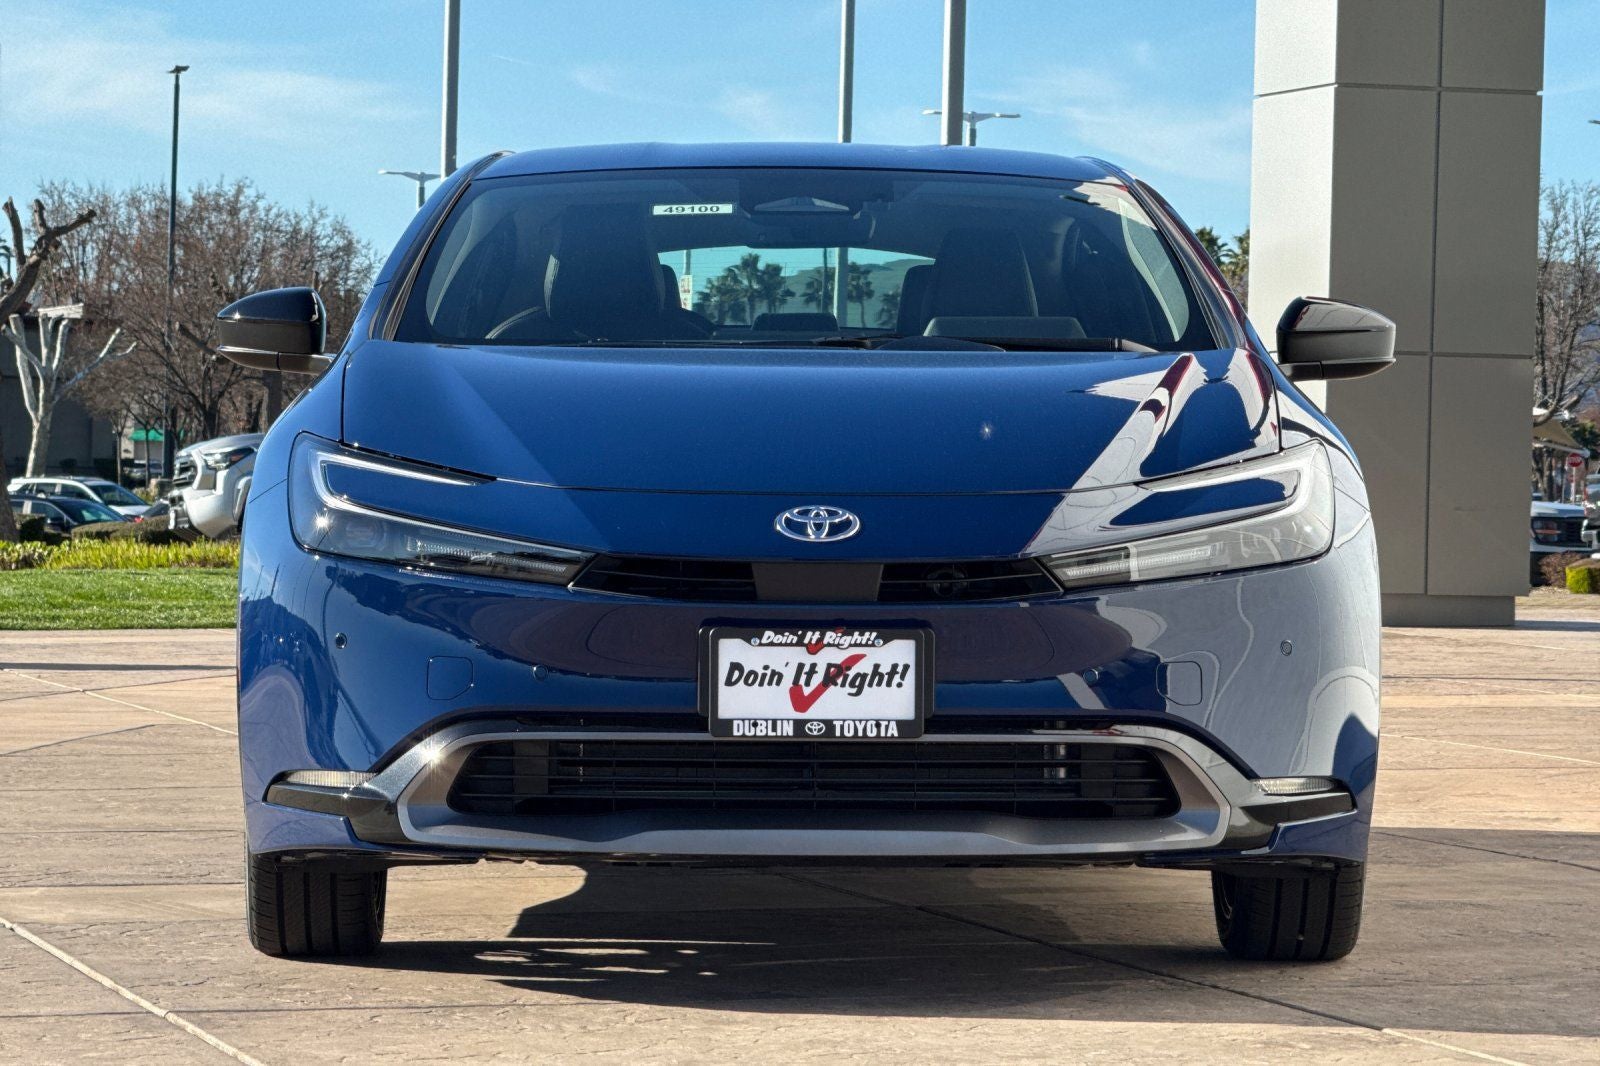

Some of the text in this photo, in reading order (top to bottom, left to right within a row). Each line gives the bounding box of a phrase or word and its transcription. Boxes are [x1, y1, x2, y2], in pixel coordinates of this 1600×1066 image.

[663, 205, 720, 213] 49100
[761, 630, 877, 648] Doin' It Right!
[724, 661, 910, 697] Doin' It Right!
[733, 720, 898, 737] DUBLIN TOYOTA
